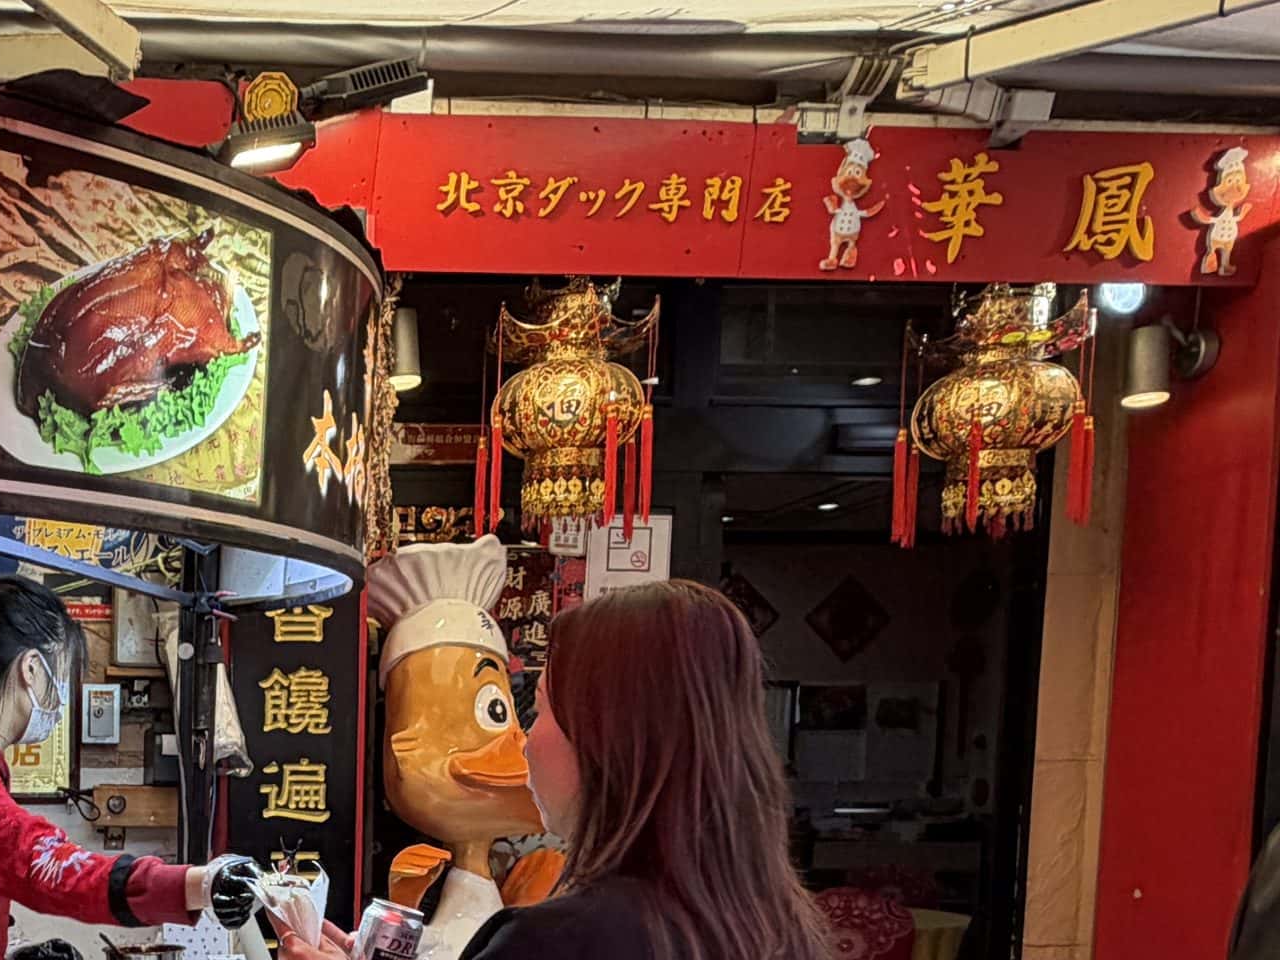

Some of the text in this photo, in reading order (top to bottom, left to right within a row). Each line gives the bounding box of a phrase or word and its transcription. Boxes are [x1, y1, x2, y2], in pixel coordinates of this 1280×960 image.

[436, 169, 793, 224] 北京ダック専門店
[920, 152, 1155, 264] 華鳳
[258, 603, 336, 882] 香饞遍
